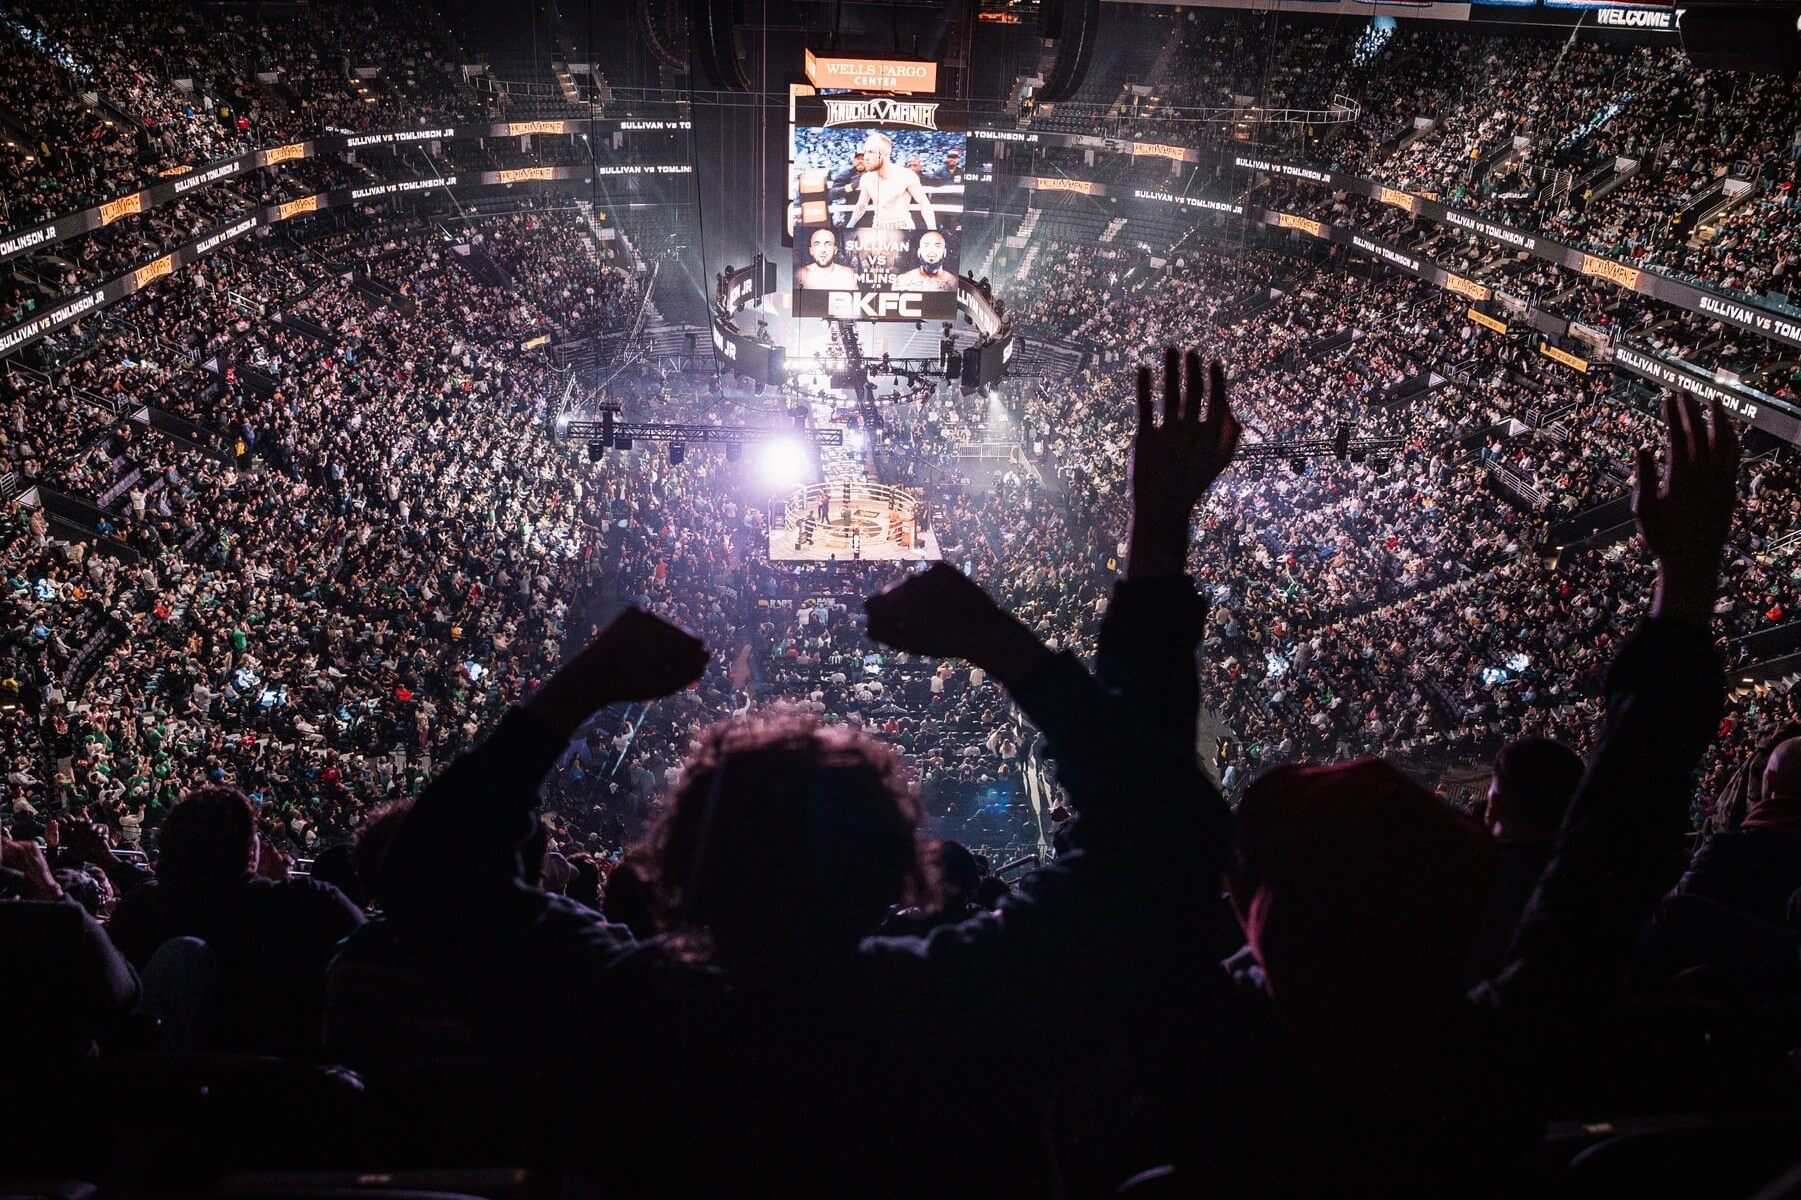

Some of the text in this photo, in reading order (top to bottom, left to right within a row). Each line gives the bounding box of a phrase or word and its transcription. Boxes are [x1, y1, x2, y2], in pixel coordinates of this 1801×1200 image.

[1598, 8, 1670, 27] WELCOME
[825, 63, 927, 78] WELLS FARGO
[854, 76, 897, 86] CENTER
[348, 128, 455, 147] SULLIVAN VS TOMLINSON JR
[974, 130, 1025, 141] TOMLINSON
[1026, 134, 1039, 142] JR
[600, 166, 641, 174] SULLIVAN
[1235, 157, 1270, 170] SULLIVAN
[1282, 165, 1321, 181] TOMLINSON
[174, 174, 200, 192] SULLIVAN
[351, 186, 386, 199] SULLIVAN
[398, 178, 445, 191] TOMLINSON
[446, 176, 457, 186] JR
[1135, 190, 1173, 202] SULLIVAN
[1186, 197, 1232, 212] TOMLINSON
[45, 226, 56, 240] JR
[1446, 211, 1475, 229] SULLIVAN
[1485, 224, 1525, 245] TOMLINSON
[1525, 236, 1536, 250] JR
[845, 240, 910, 252] SULLIVAN
[1353, 235, 1375, 251] SULLIVAN
[867, 255, 887, 265] VS
[741, 278, 752, 296] JR
[39, 318, 51, 330] VS
[51, 295, 95, 325] TOMLINSON
[95, 290, 105, 303] JR
[828, 291, 923, 318] BKFC
[1700, 296, 1754, 324] SULLIVAN
[1756, 315, 1771, 330] VS
[1616, 348, 1661, 377] SULLIVAN
[1663, 369, 1675, 383] VS
[1740, 403, 1758, 419] JR
